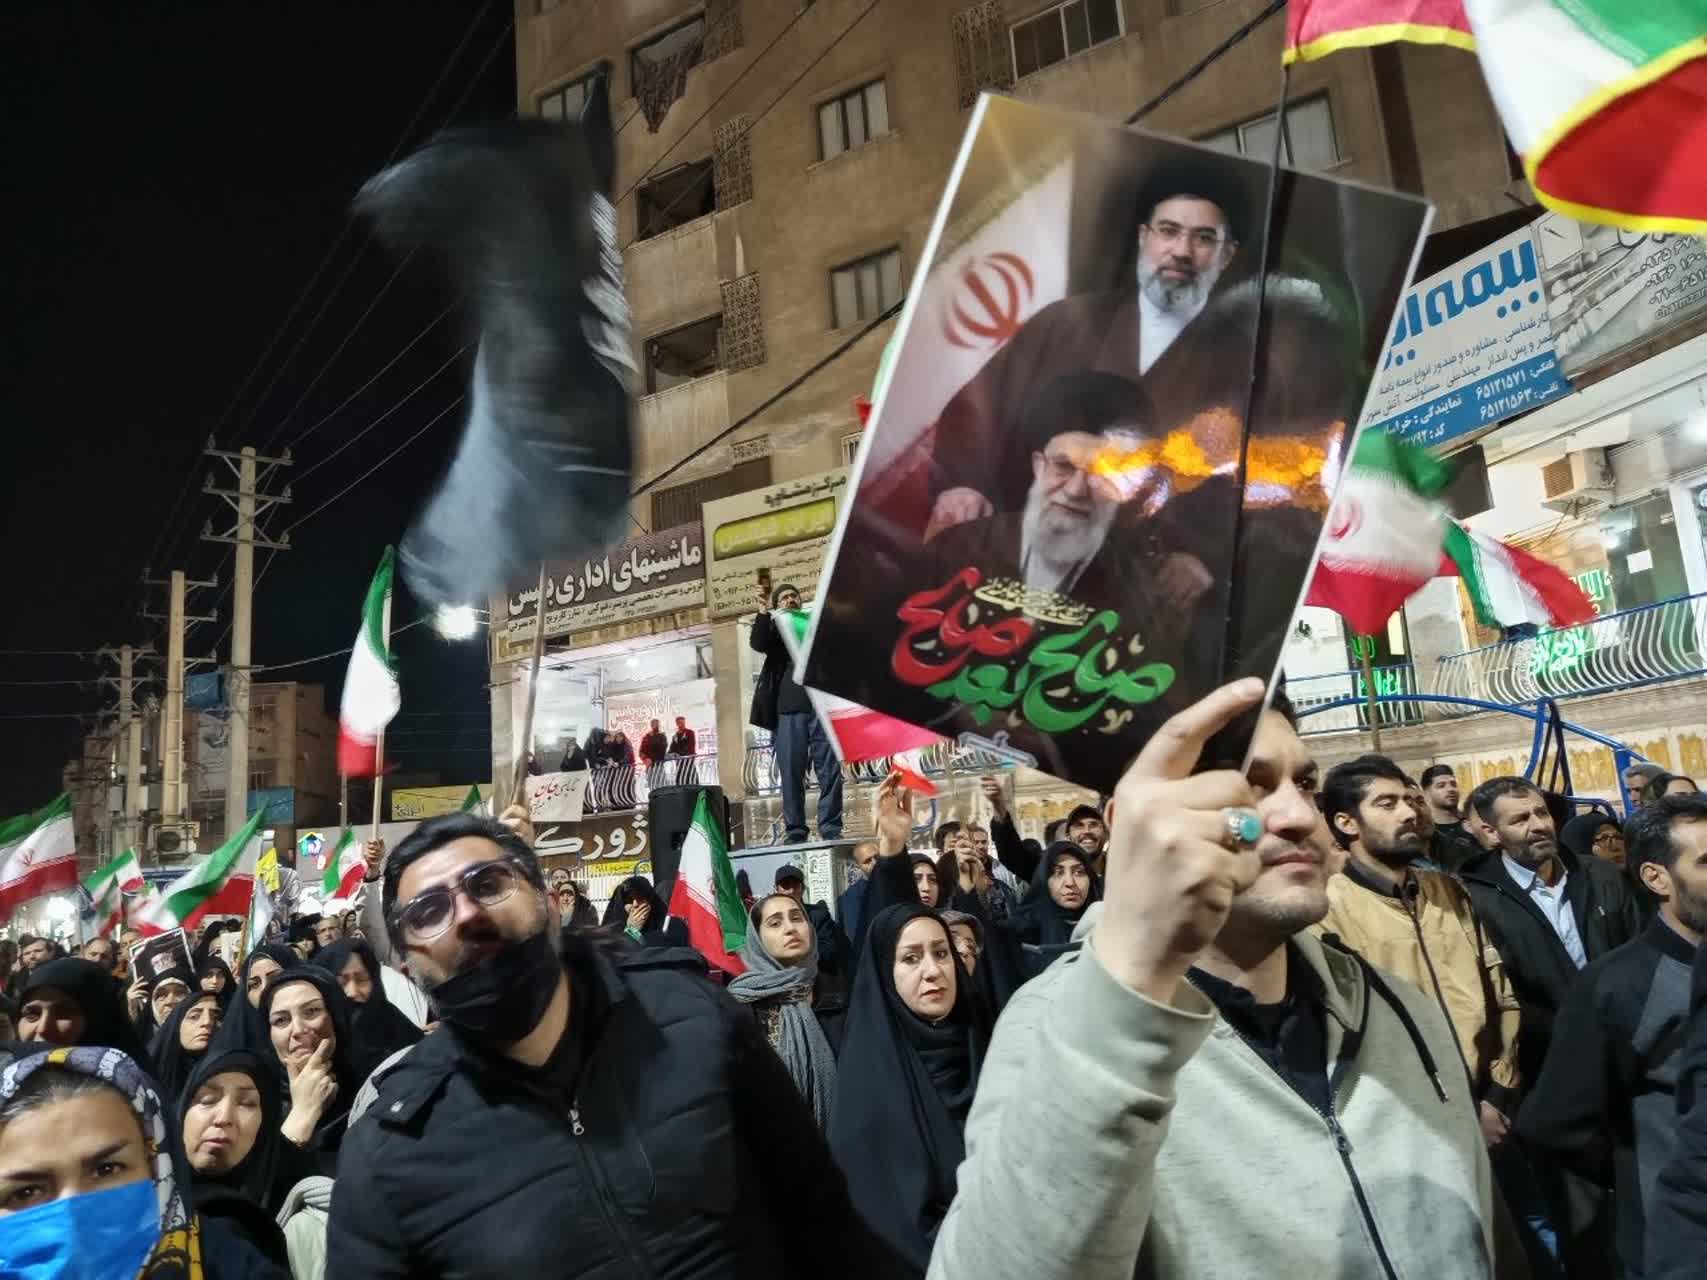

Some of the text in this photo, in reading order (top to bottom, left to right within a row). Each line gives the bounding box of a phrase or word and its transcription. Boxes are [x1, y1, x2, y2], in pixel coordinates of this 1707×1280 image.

[1425, 240, 1540, 328] بیمه
[556, 555, 610, 606] اداری
[612, 535, 702, 592] ماشینهای
